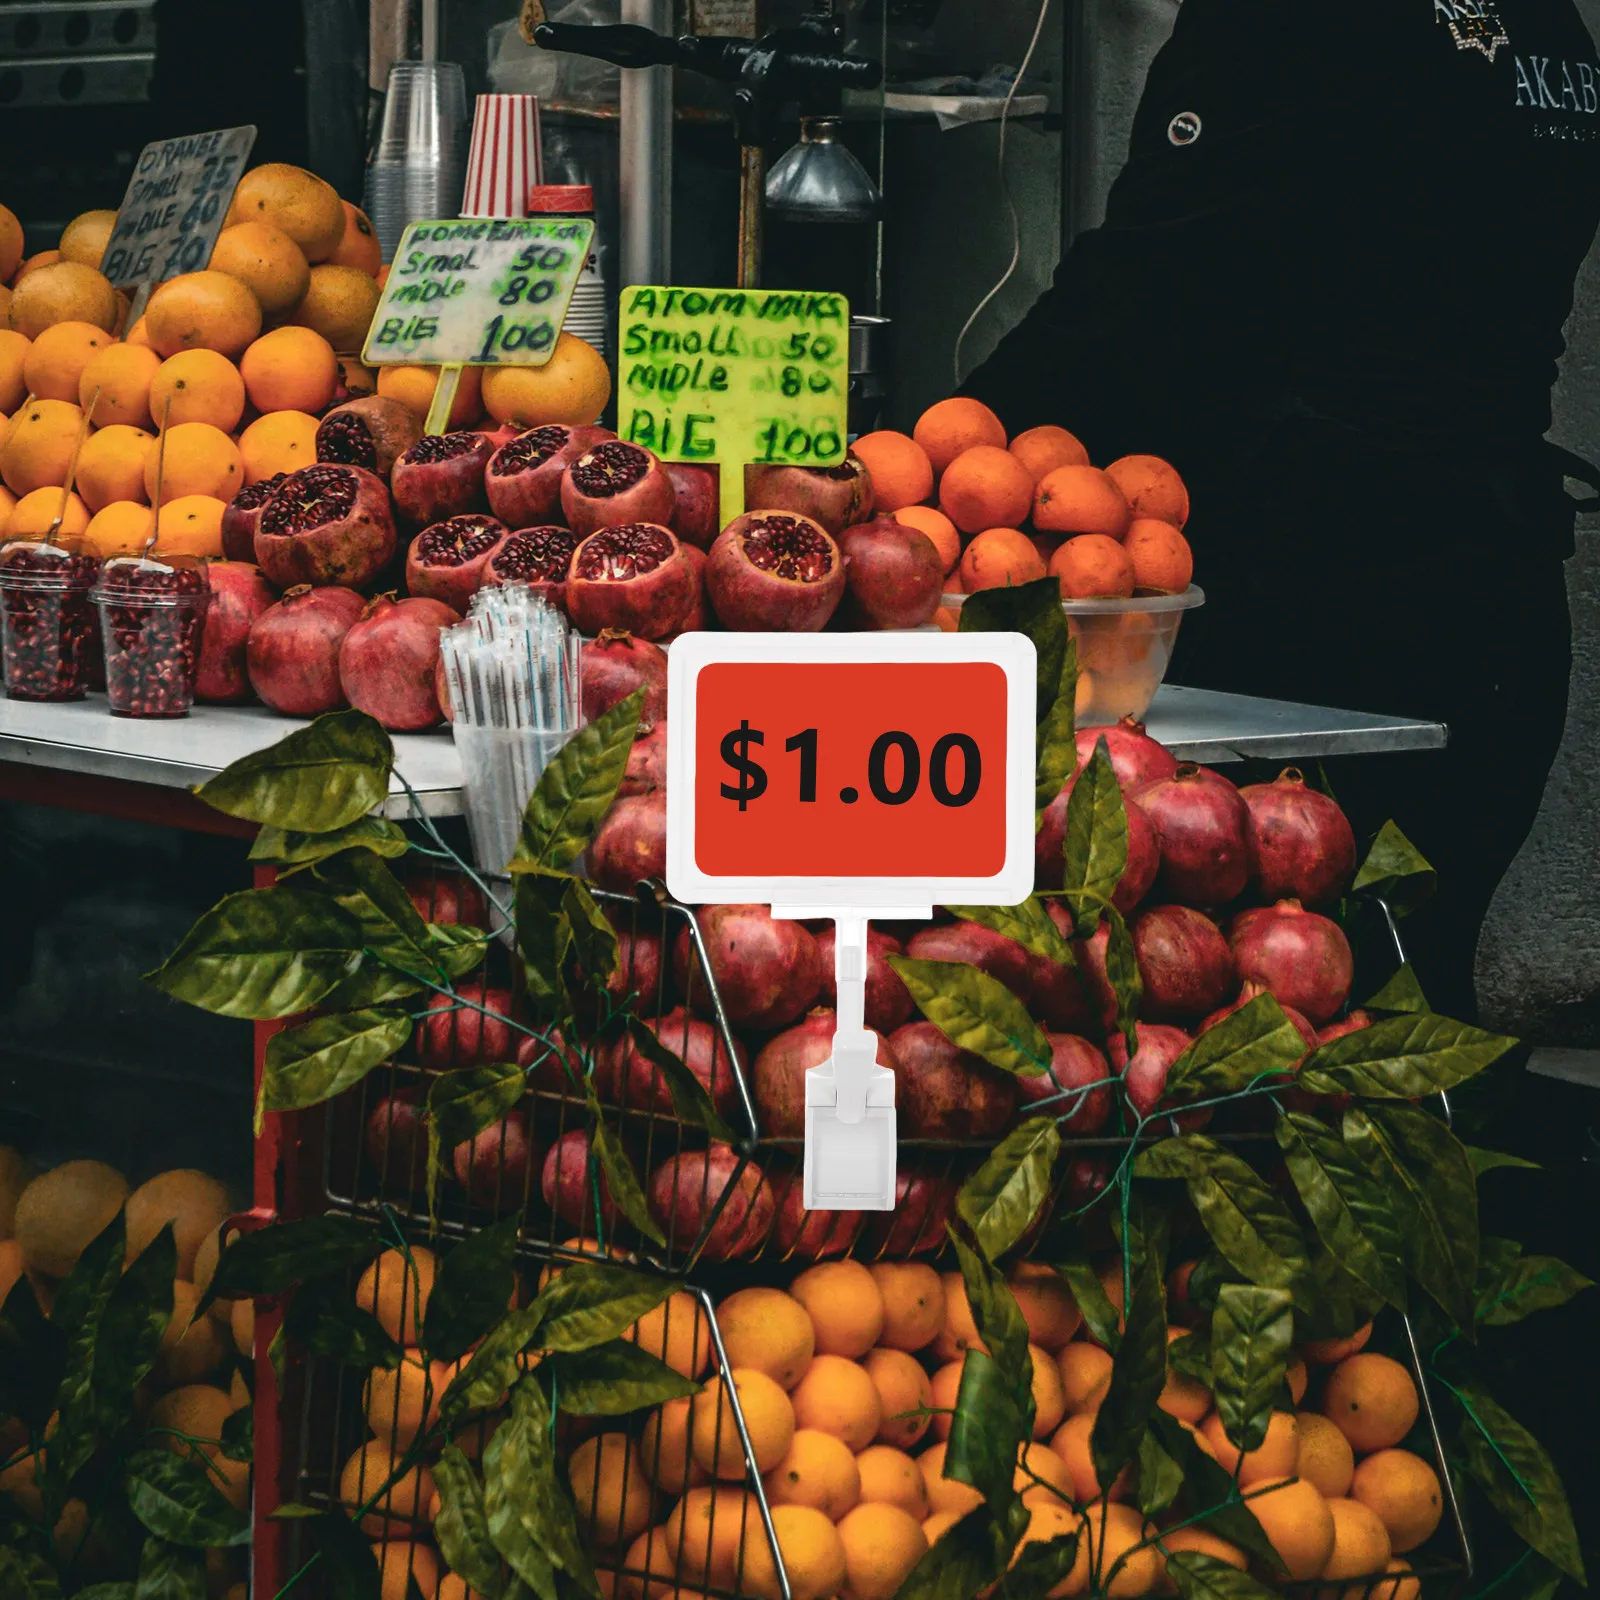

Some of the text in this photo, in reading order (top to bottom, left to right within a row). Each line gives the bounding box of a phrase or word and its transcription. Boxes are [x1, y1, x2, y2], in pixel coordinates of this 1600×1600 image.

[1515, 55, 1600, 113] AKAB
[512, 245, 567, 272] 50
[498, 276, 555, 306] 80
[469, 314, 554, 363] 100
[782, 332, 836, 361] 50
[781, 366, 832, 397] 80
[752, 417, 842, 463] 100
[719, 719, 982, 812] $1.00
